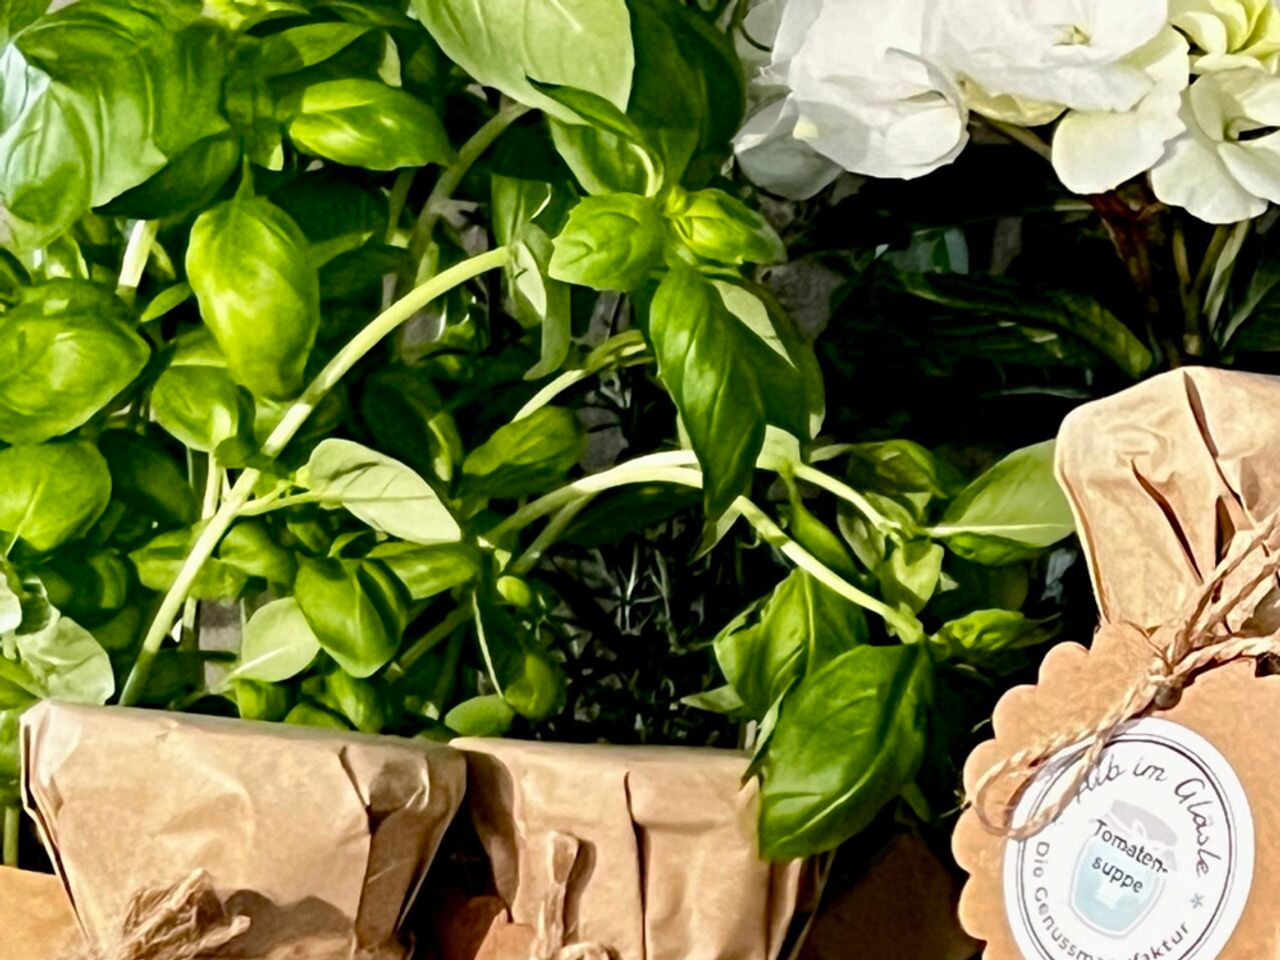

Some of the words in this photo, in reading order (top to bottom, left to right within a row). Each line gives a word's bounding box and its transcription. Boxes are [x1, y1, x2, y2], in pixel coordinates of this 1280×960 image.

[1032, 841, 1050, 878] Die
[1093, 818, 1169, 874] Tomaten-
[1091, 856, 1144, 893] suppe
